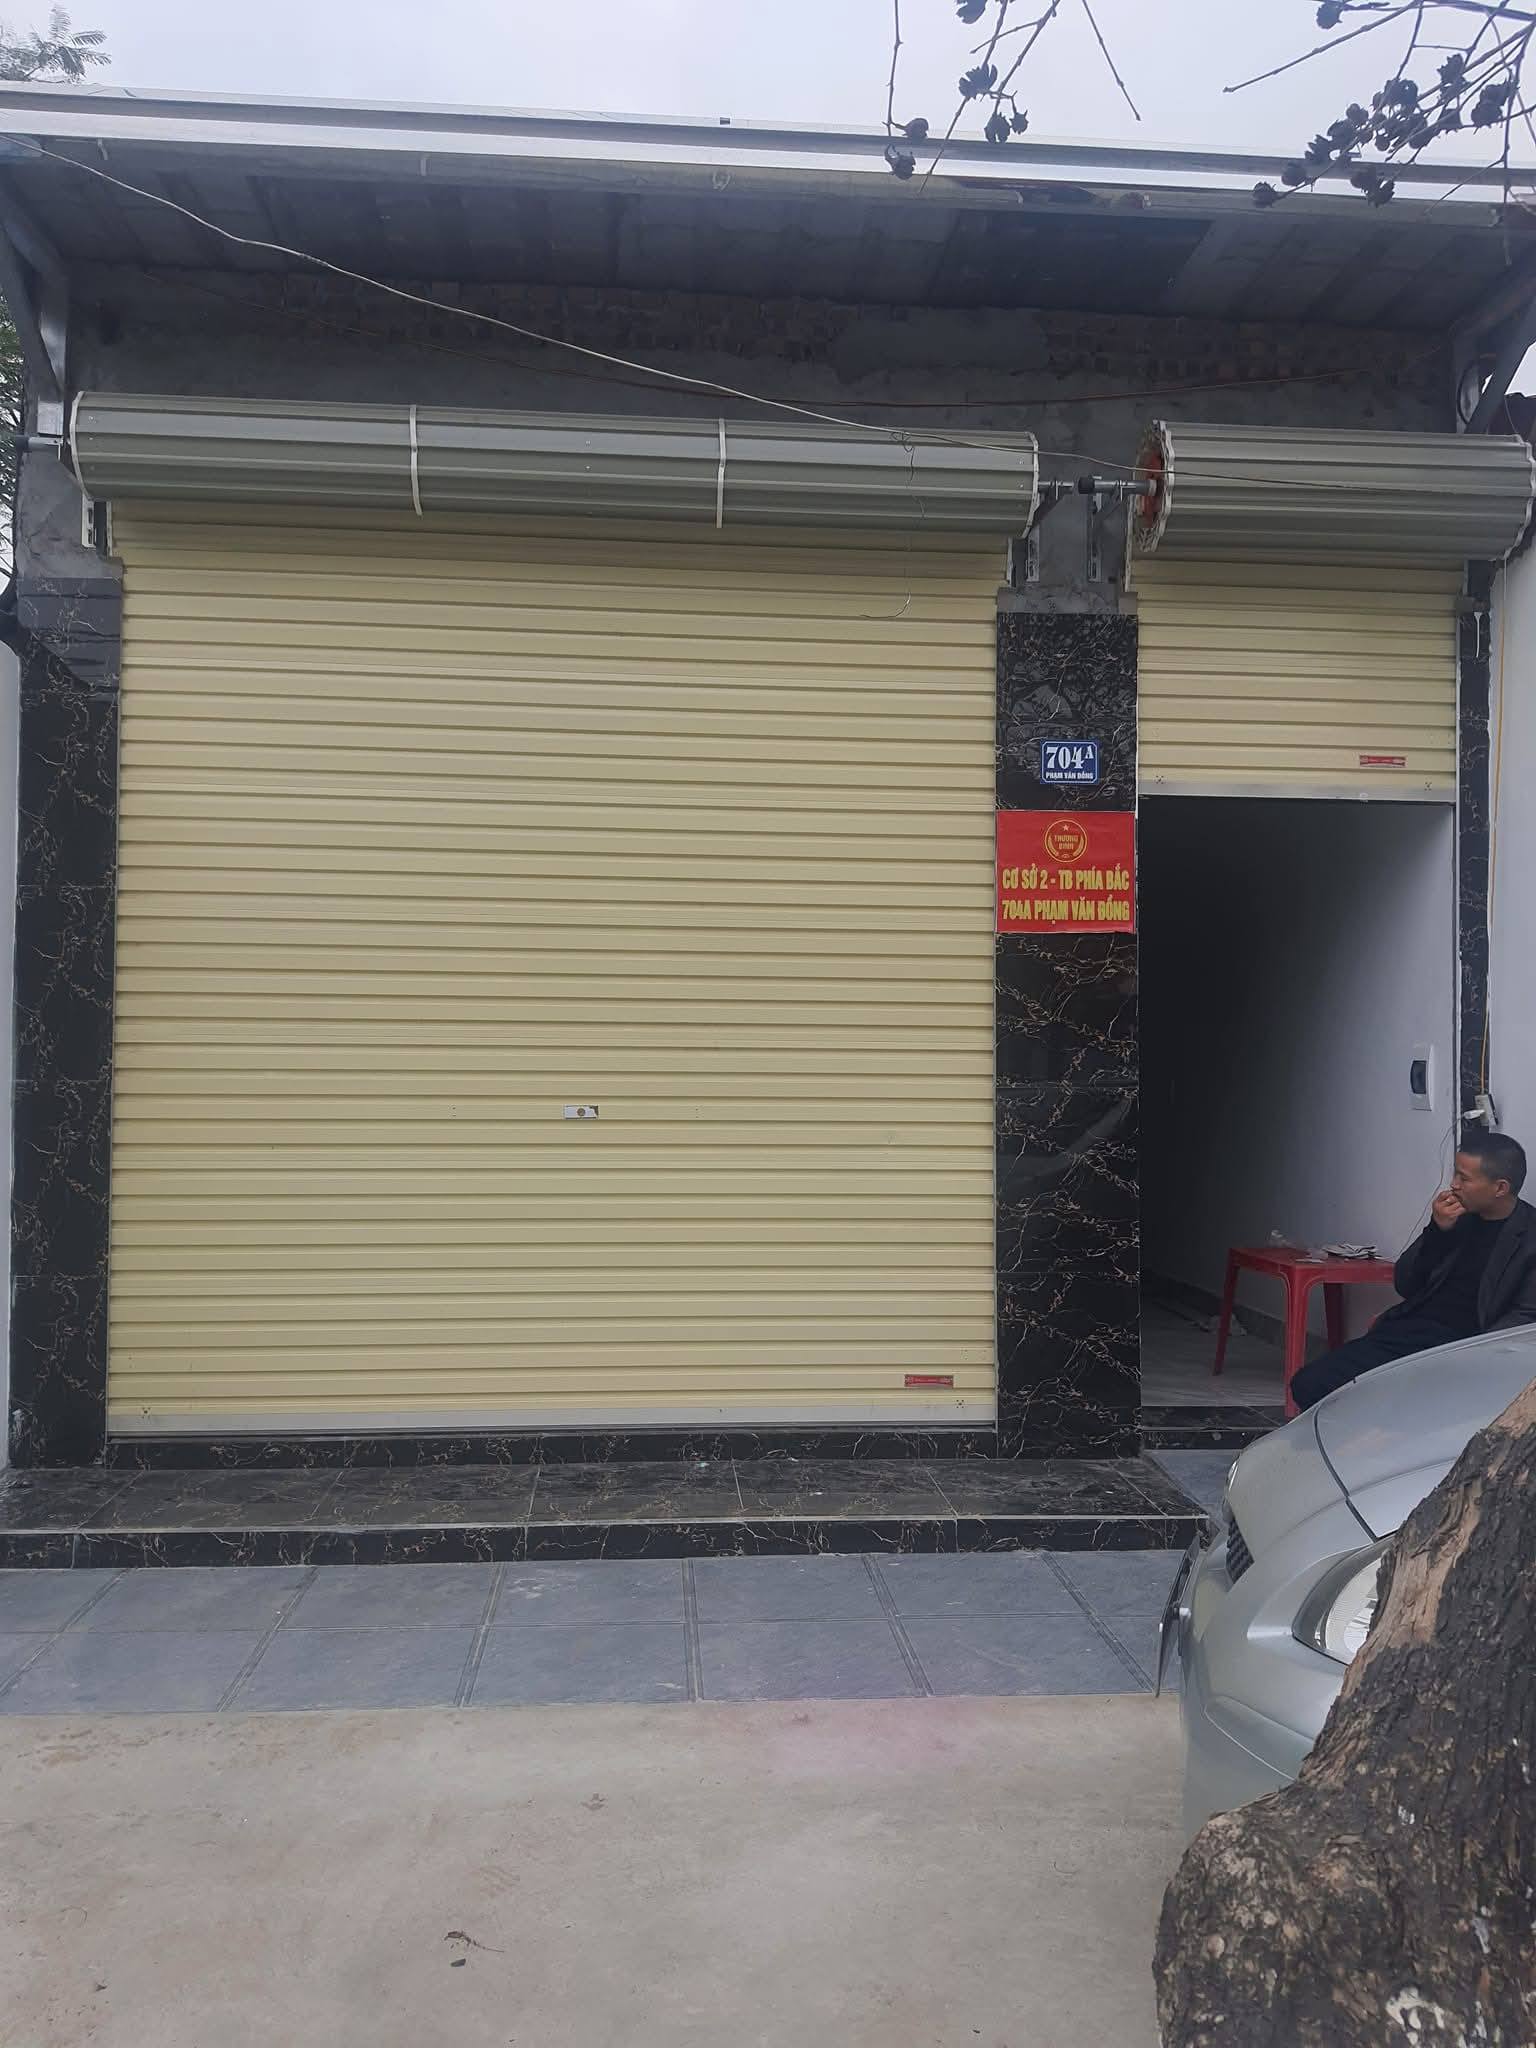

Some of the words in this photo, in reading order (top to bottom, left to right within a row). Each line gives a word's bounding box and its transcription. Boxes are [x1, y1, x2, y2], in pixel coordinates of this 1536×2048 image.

[1002, 867, 1019, 889] CƠ
[1021, 863, 1038, 889] SỞ
[1040, 869, 1048, 889] 2
[1058, 869, 1073, 889] TB
[1075, 865, 1103, 890] PHÍA
[1105, 863, 1130, 890] BẮC
[1002, 900, 1032, 920] 704A
[1034, 899, 1068, 925] PHẠM
[1071, 896, 1095, 921] VĂN
